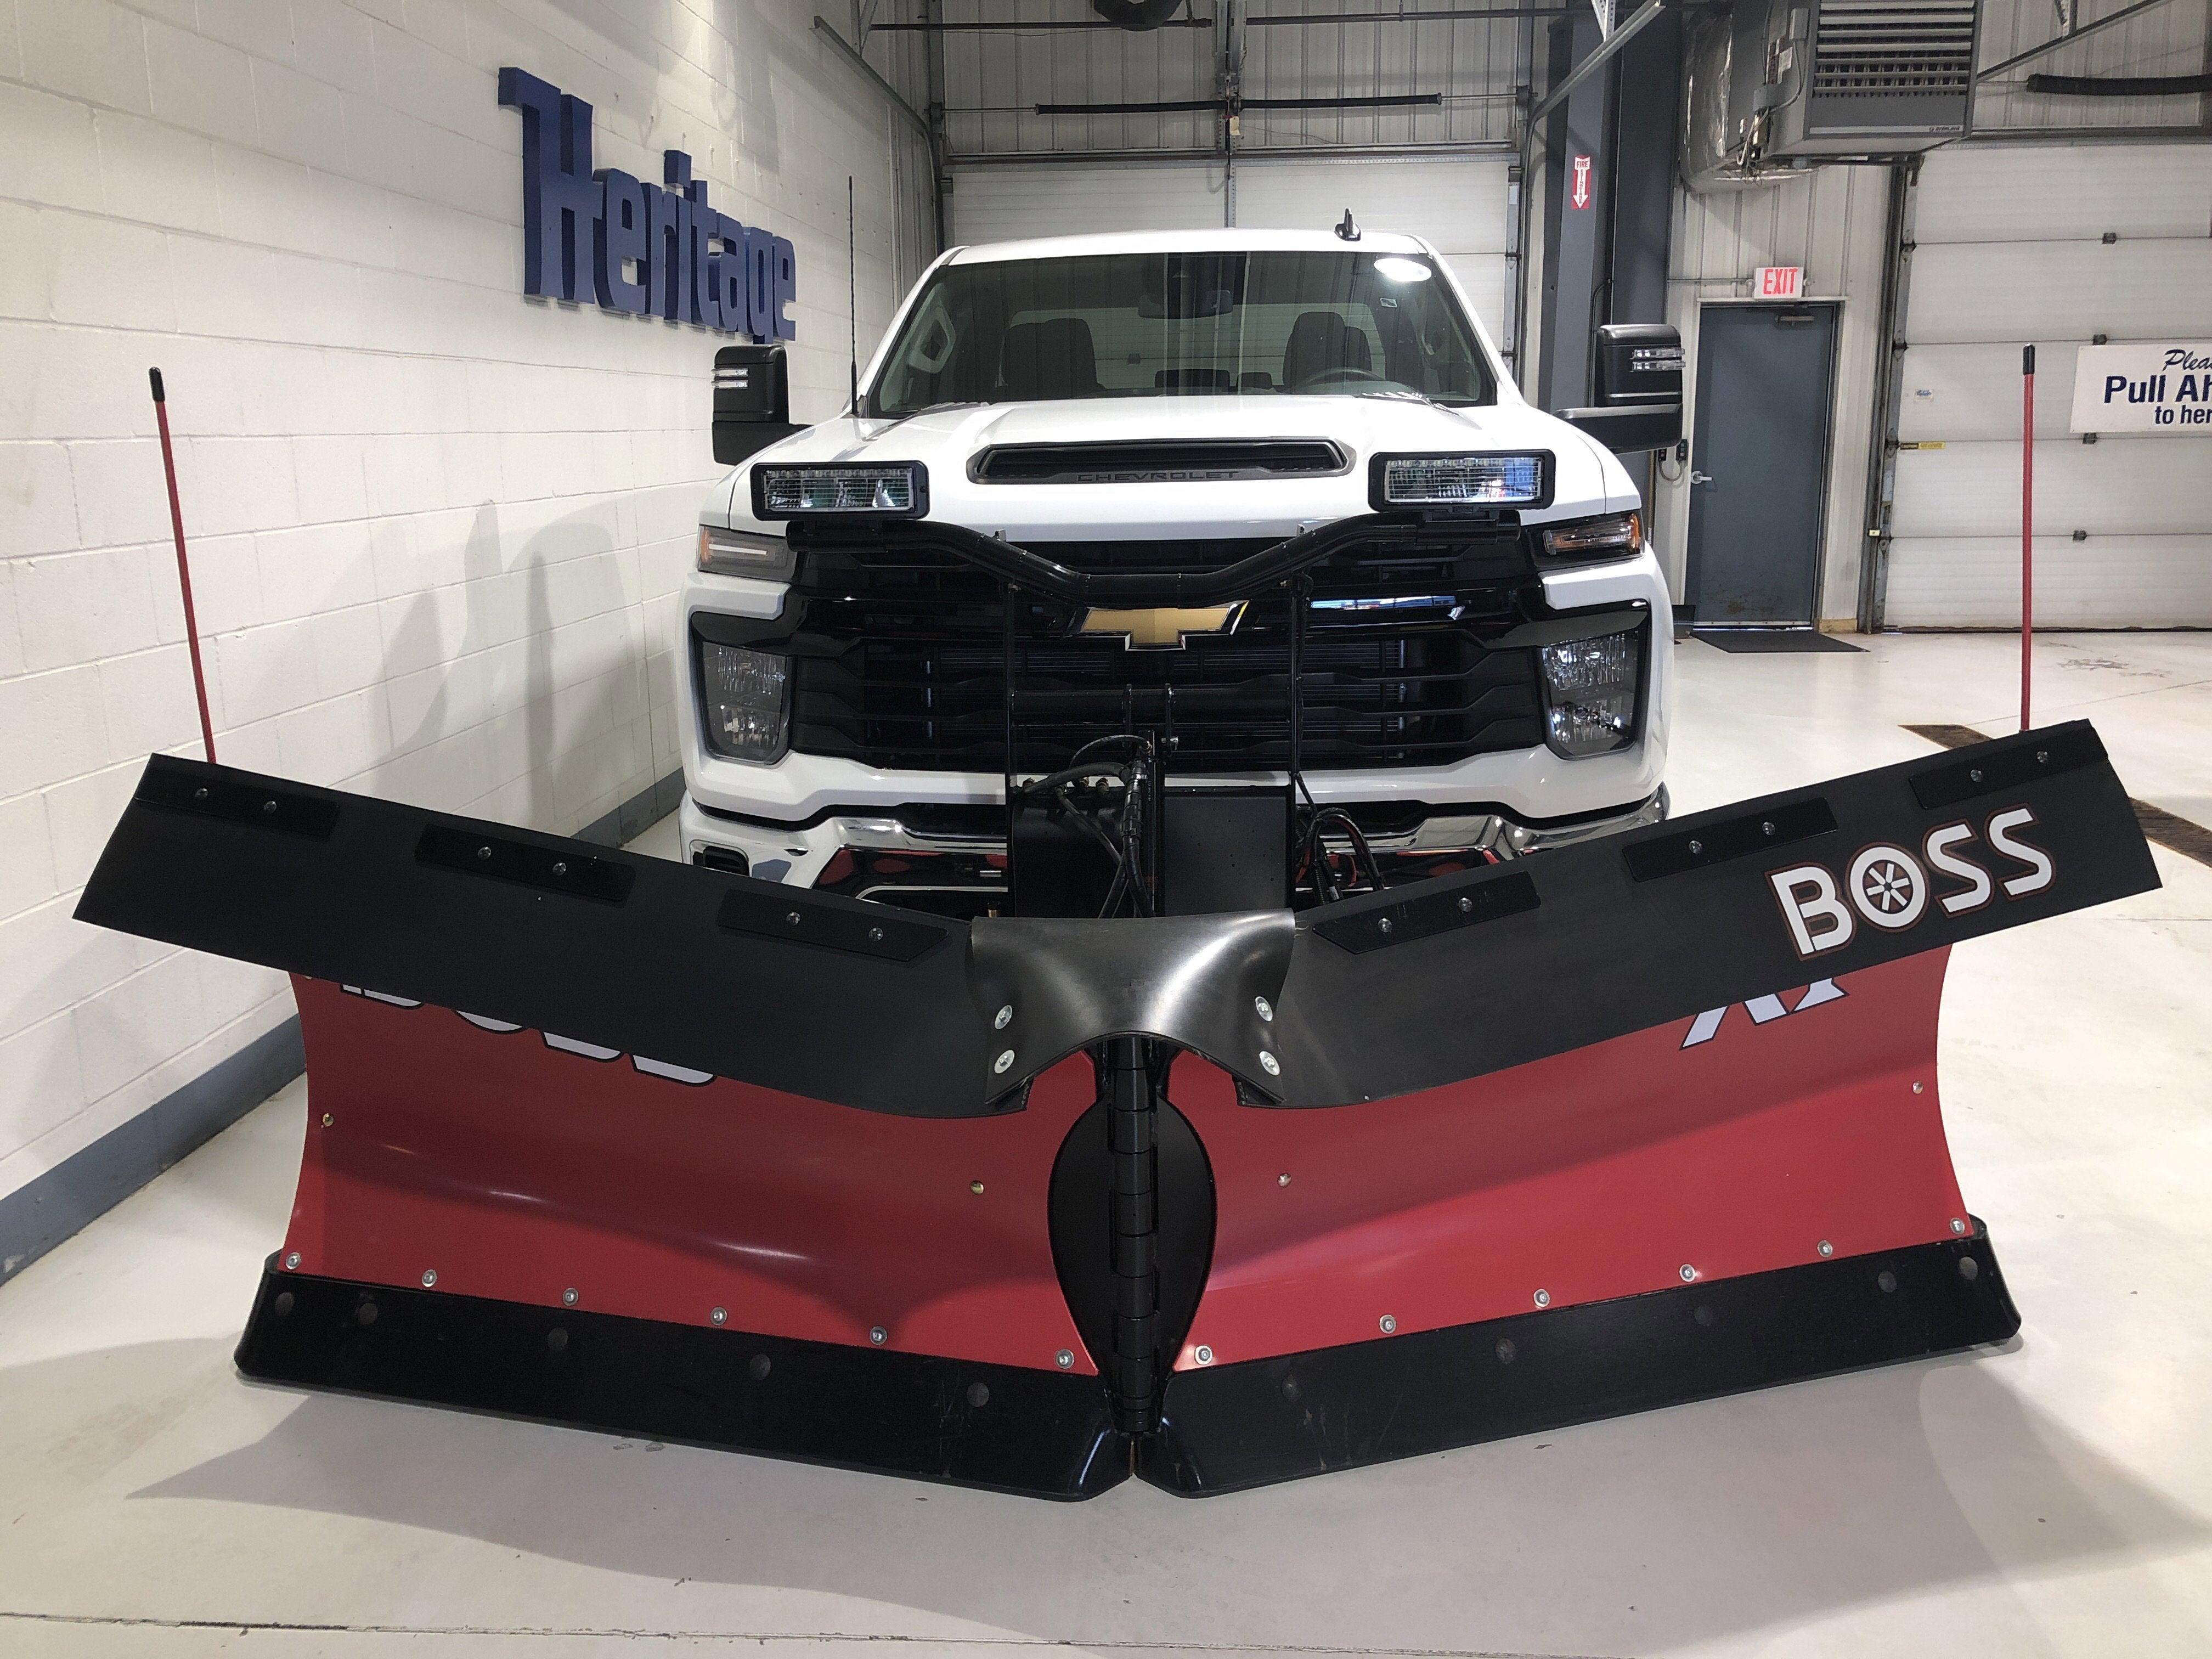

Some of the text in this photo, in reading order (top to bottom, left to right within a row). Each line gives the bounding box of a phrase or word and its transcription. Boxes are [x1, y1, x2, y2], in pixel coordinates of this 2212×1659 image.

[498, 67, 796, 345] Heritage
[1763, 268, 1798, 295] EXIT
[2103, 375, 2166, 403] Pull
[2154, 405, 2174, 424] to
[1077, 471, 1239, 482] CHEVROLET
[1767, 804, 2055, 960] BOSS
